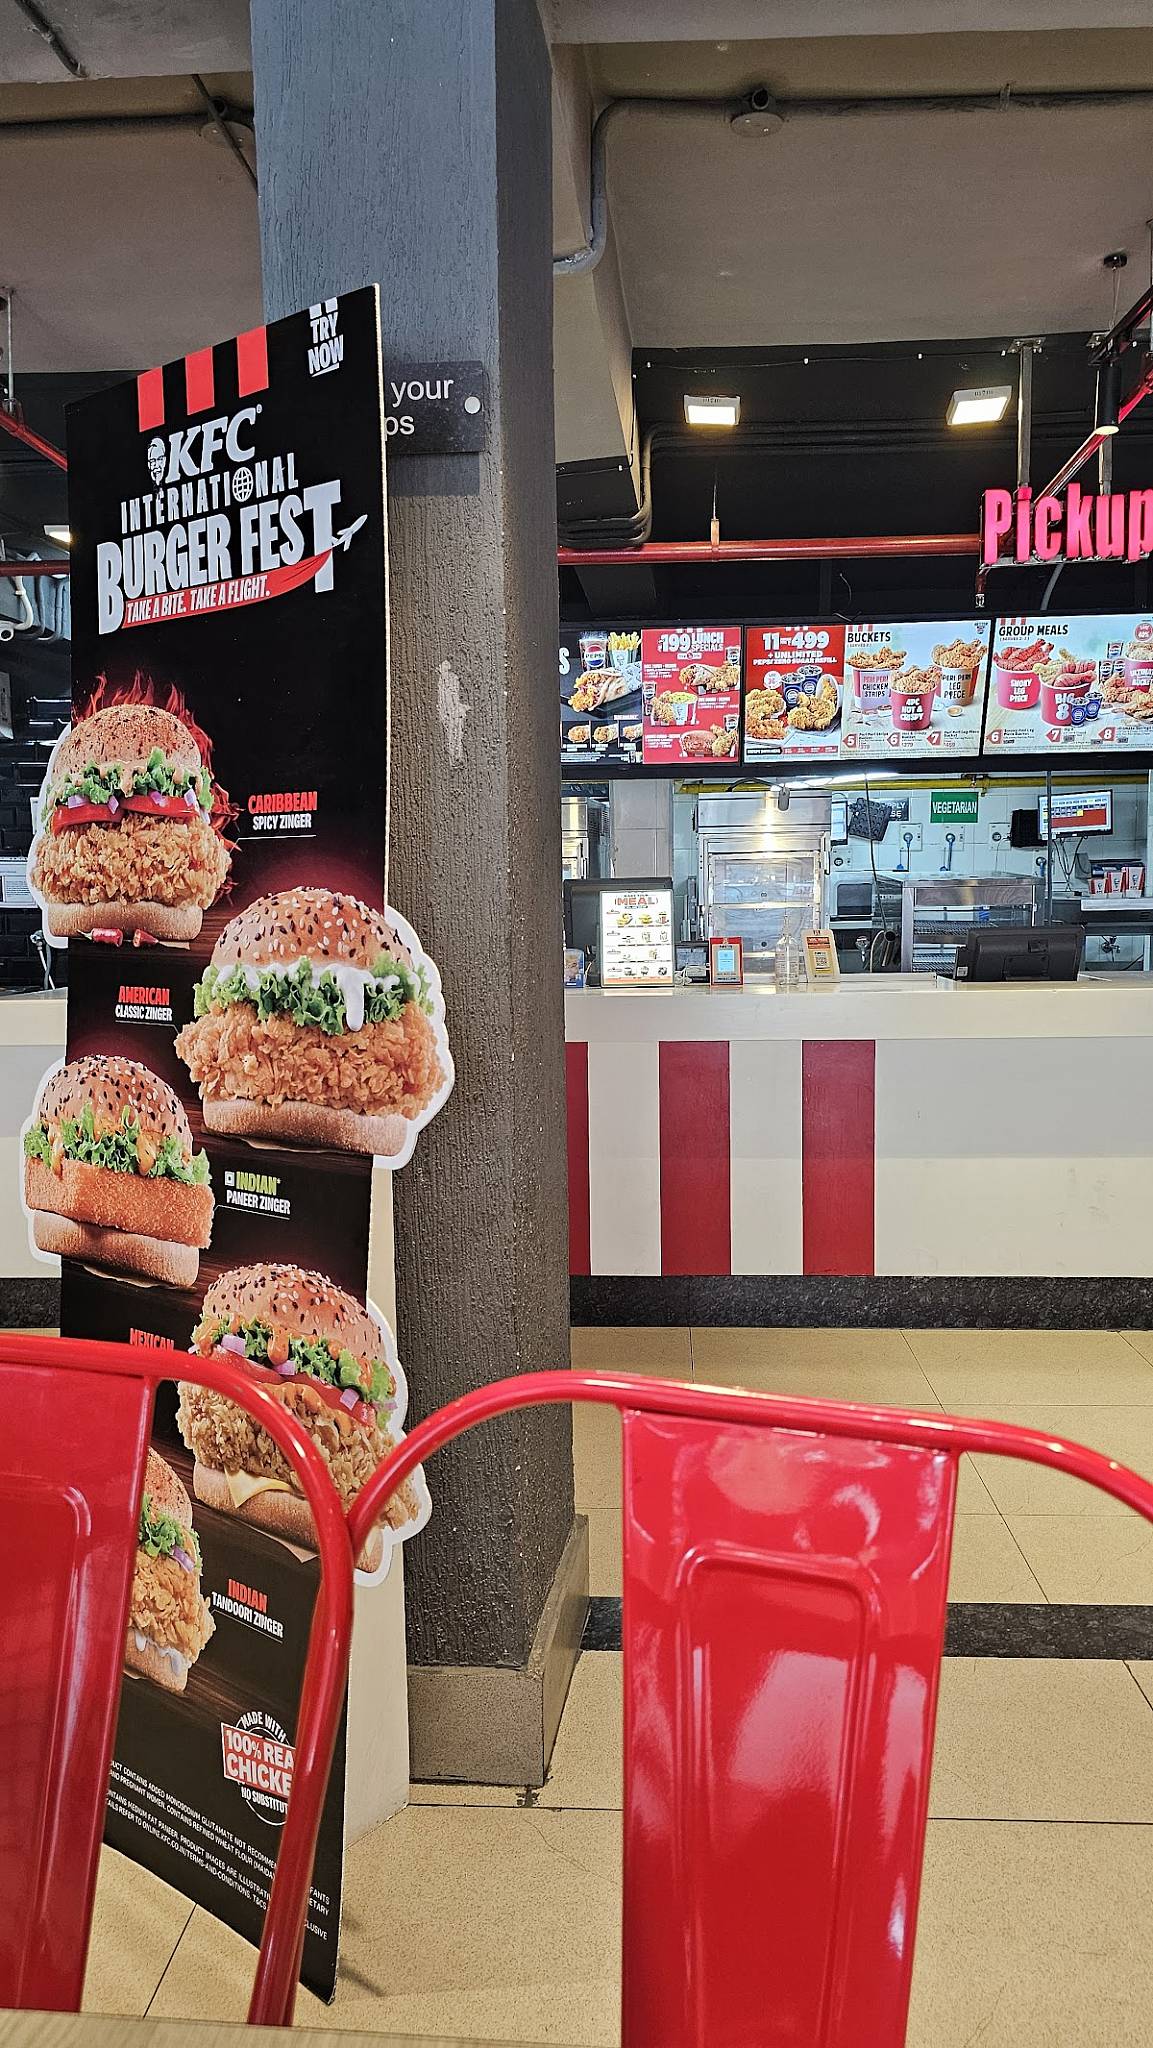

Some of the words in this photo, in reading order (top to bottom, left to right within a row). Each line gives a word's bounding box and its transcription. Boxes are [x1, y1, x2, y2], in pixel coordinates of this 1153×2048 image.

[310, 312, 338, 343] TRY
[308, 334, 344, 374] NOW
[390, 379, 454, 408] your
[121, 453, 298, 534] INTERNATIONAL
[984, 482, 1153, 565] Pickup
[97, 513, 232, 634] BURGER
[240, 479, 341, 593] FEST
[126, 599, 152, 623] TAKE
[152, 598, 160, 619] A
[160, 592, 187, 616] BITE.
[190, 586, 217, 611] TAKE
[217, 585, 226, 606] A
[227, 575, 270, 604] FLIGHT.
[691, 632, 724, 644] LUNCH
[763, 632, 780, 651] 11
[791, 631, 830, 649] 499
[847, 632, 891, 643] BUCKETS
[999, 626, 1035, 637] GROUP
[1036, 624, 1069, 636] MEALS
[691, 643, 724, 652] SPECIALS
[774, 650, 823, 659] UNLIMITED
[862, 683, 889, 691] CHICKEN
[949, 682, 961, 690] LEG
[847, 736, 855, 746] 5
[891, 734, 899, 745] 6
[932, 733, 939, 743] 7
[991, 732, 999, 742] 6
[1051, 730, 1060, 741] 7
[1103, 729, 1112, 740] 8
[248, 791, 318, 814] CARIBBEAN
[932, 801, 977, 814] VEGETARIAN
[252, 814, 279, 830] SPICY
[279, 813, 312, 829] ZINGER
[118, 985, 170, 1006] AMERICAN
[115, 1004, 145, 1020] CLASSIC
[144, 1006, 173, 1022] ZINGER
[226, 1189, 259, 1209] PANEER
[259, 1195, 291, 1215] ZINGER
[129, 1327, 175, 1352] MEXICAN
[228, 1578, 268, 1613] INDIAN
[211, 1591, 253, 1623] TANDOORI
[253, 1611, 284, 1638] ZINGER
[240, 1711, 263, 1730] MADE
[264, 1713, 287, 1743] WITH
[225, 1729, 262, 1760] 100%
[263, 1742, 295, 1772] REA
[226, 1752, 293, 1796] CHICKE
[241, 1786, 252, 1800] NO
[112, 1760, 123, 1772] UCT
[123, 1766, 148, 1787] CONTAINS
[148, 1782, 166, 1798] ADDED
[165, 1793, 201, 1821] MONOSODIUM
[201, 1815, 234, 1842] GLUTAMATE
[234, 1837, 246, 1850] NOT
[119, 1805, 135, 1821] REFER
[135, 1815, 142, 1826] TO
[120, 1774, 146, 1797] PREGNANT
[166, 1804, 192, 1827] CONTAINS
[192, 1821, 215, 1841] REFINED
[214, 1835, 235, 1853] WHEAT
[234, 1848, 253, 1866] FLOUR
[127, 1800, 148, 1819] MEDIUM
[147, 1813, 158, 1825] FAT
[180, 1834, 205, 1856] PRODUCT
[205, 1851, 226, 1870] IMAGES
[226, 1865, 238, 1879] ARE
